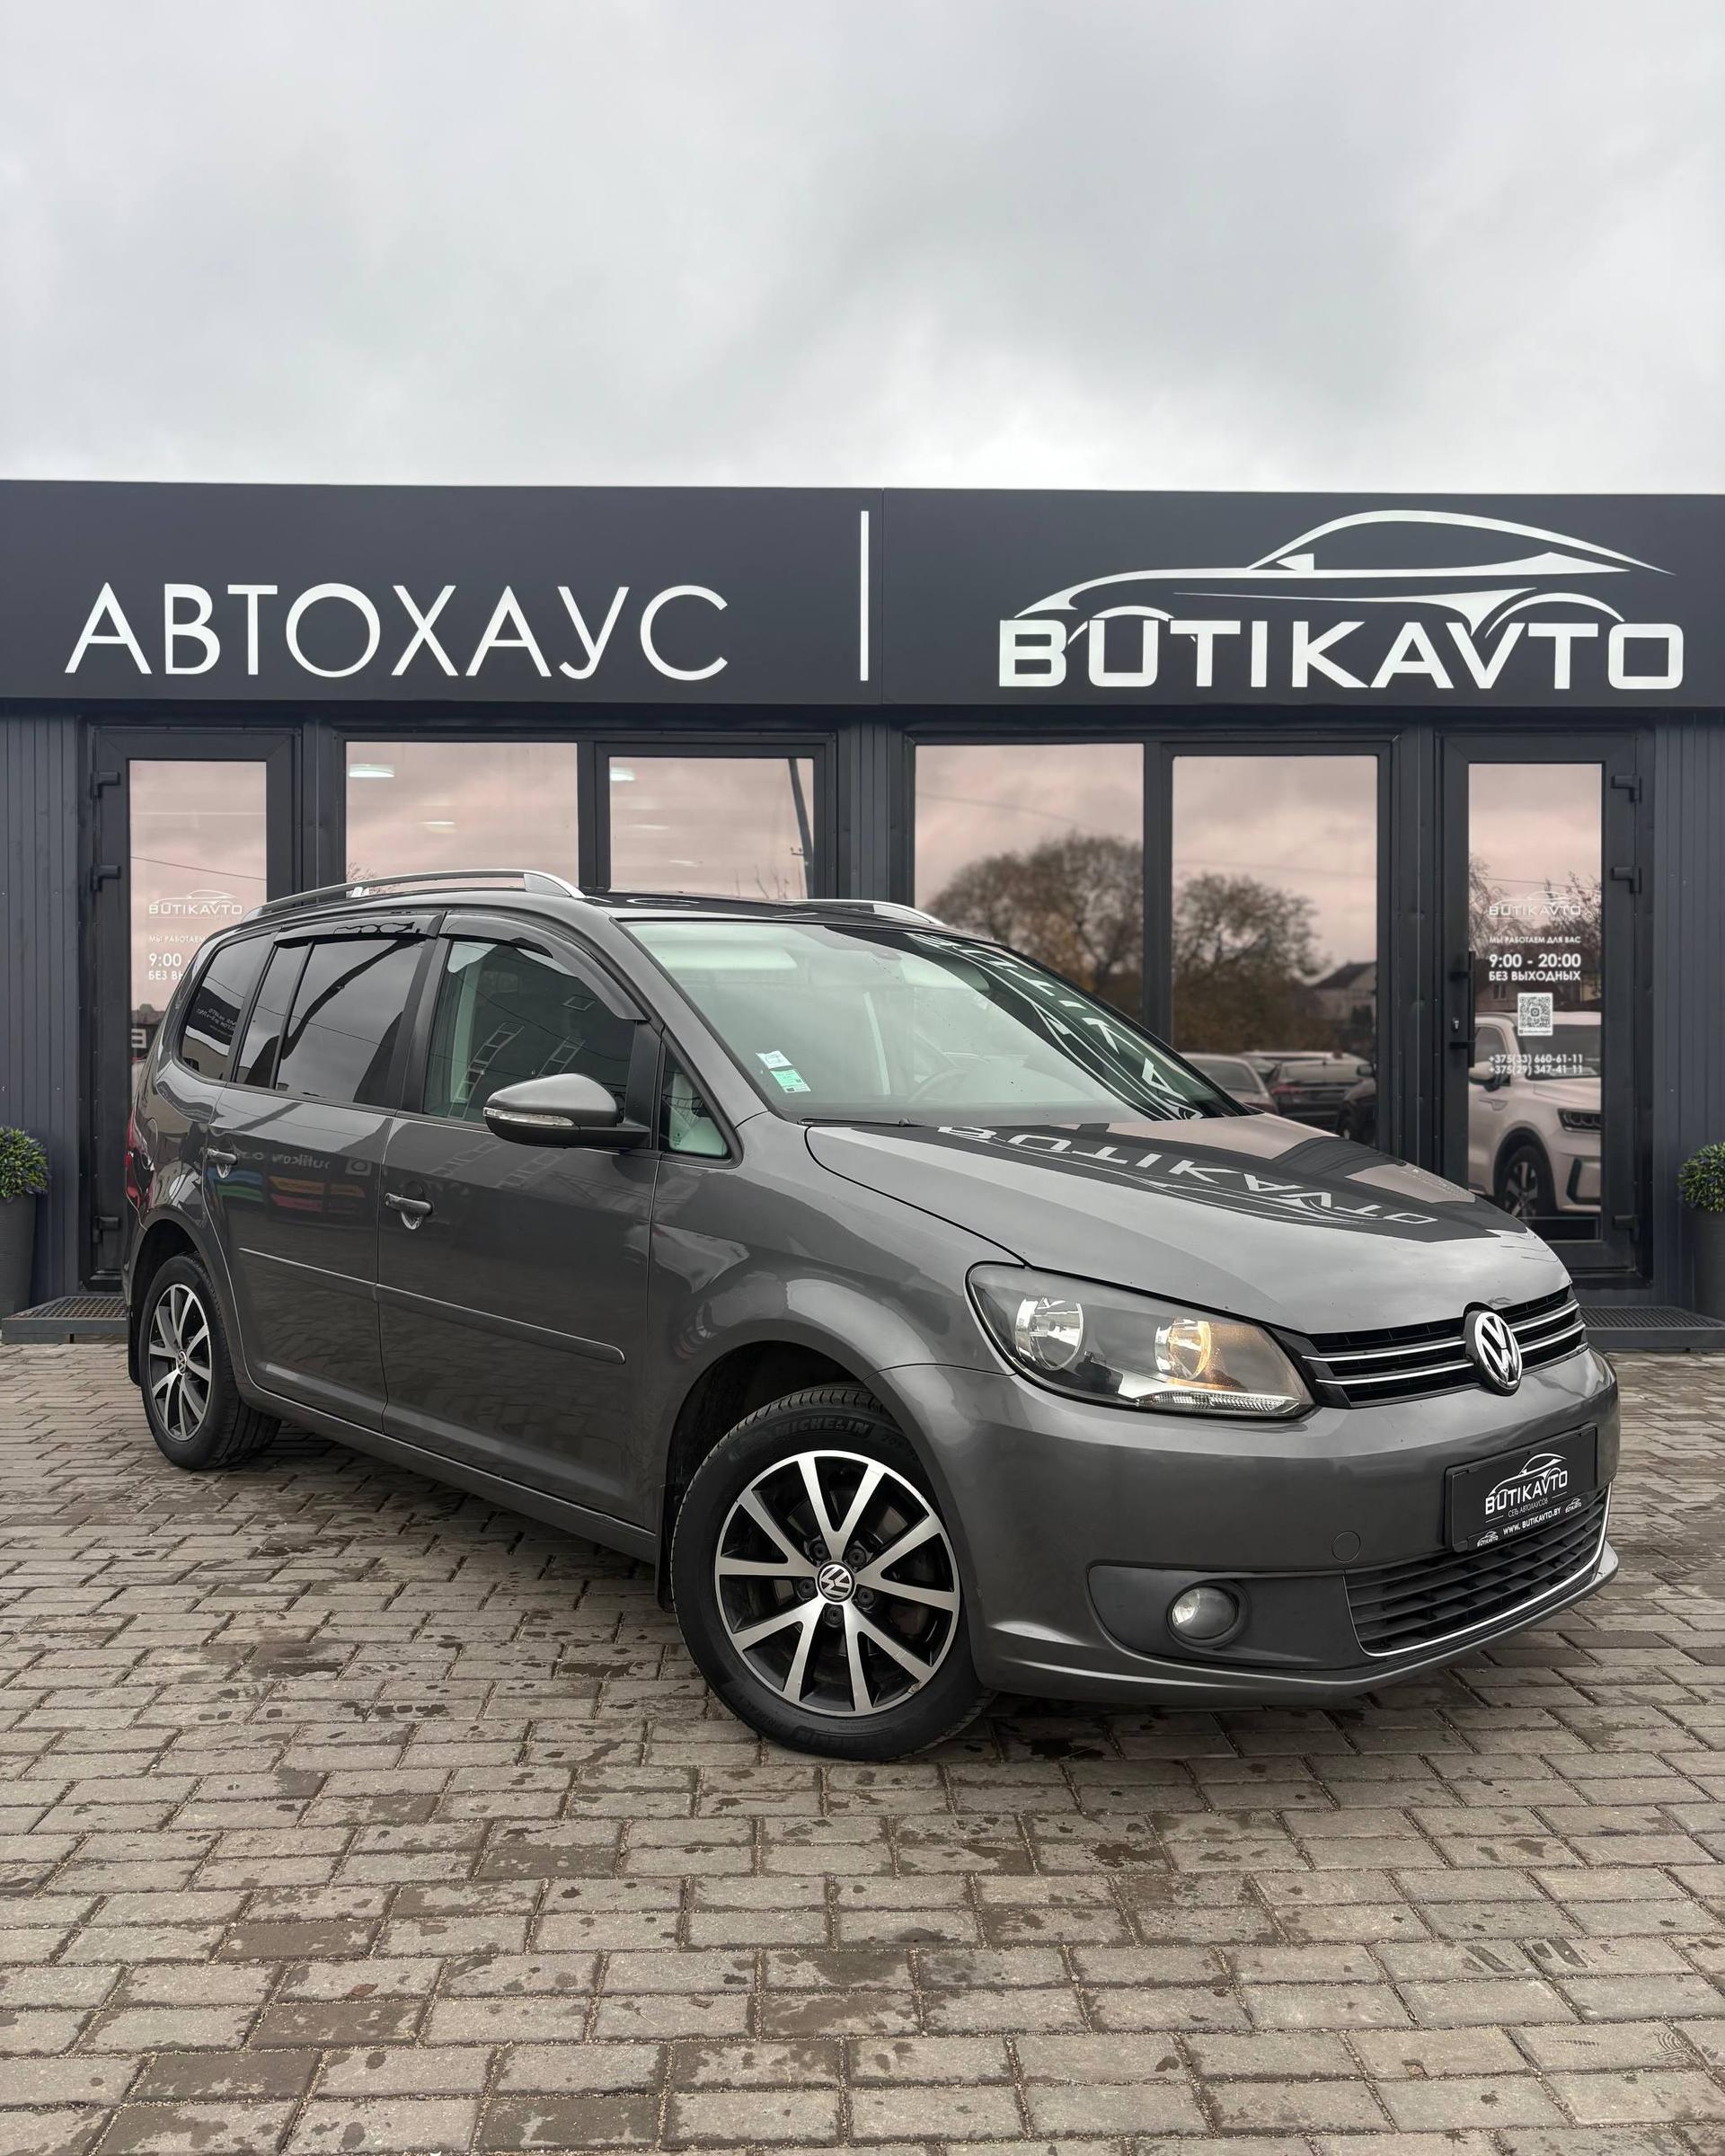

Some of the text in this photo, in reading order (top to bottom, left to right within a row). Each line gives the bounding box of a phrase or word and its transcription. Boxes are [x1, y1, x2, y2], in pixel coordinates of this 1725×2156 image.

[65, 581, 729, 680] АВТОХАУС
[998, 618, 1685, 690] BUTIKAVTO
[149, 905, 242, 915] BUTIKAVTO
[1489, 905, 1581, 915] BUTIKAVTO
[1546, 936, 1563, 944] ДЛЯ
[148, 952, 182, 967] 9:00
[1489, 953, 1522, 968] 9:00
[1538, 953, 1581, 968] 20:00
[148, 971, 168, 980] БЕЗ
[1489, 971, 1581, 982] БЕЗ ВЫХОДНЫХ
[1488, 1054, 1583, 1065] +375(33) 660-61-11
[1488, 1065, 1583, 1076] +375(29) 347-4111
[1485, 1470, 1568, 1515] BUTIKAVTO
